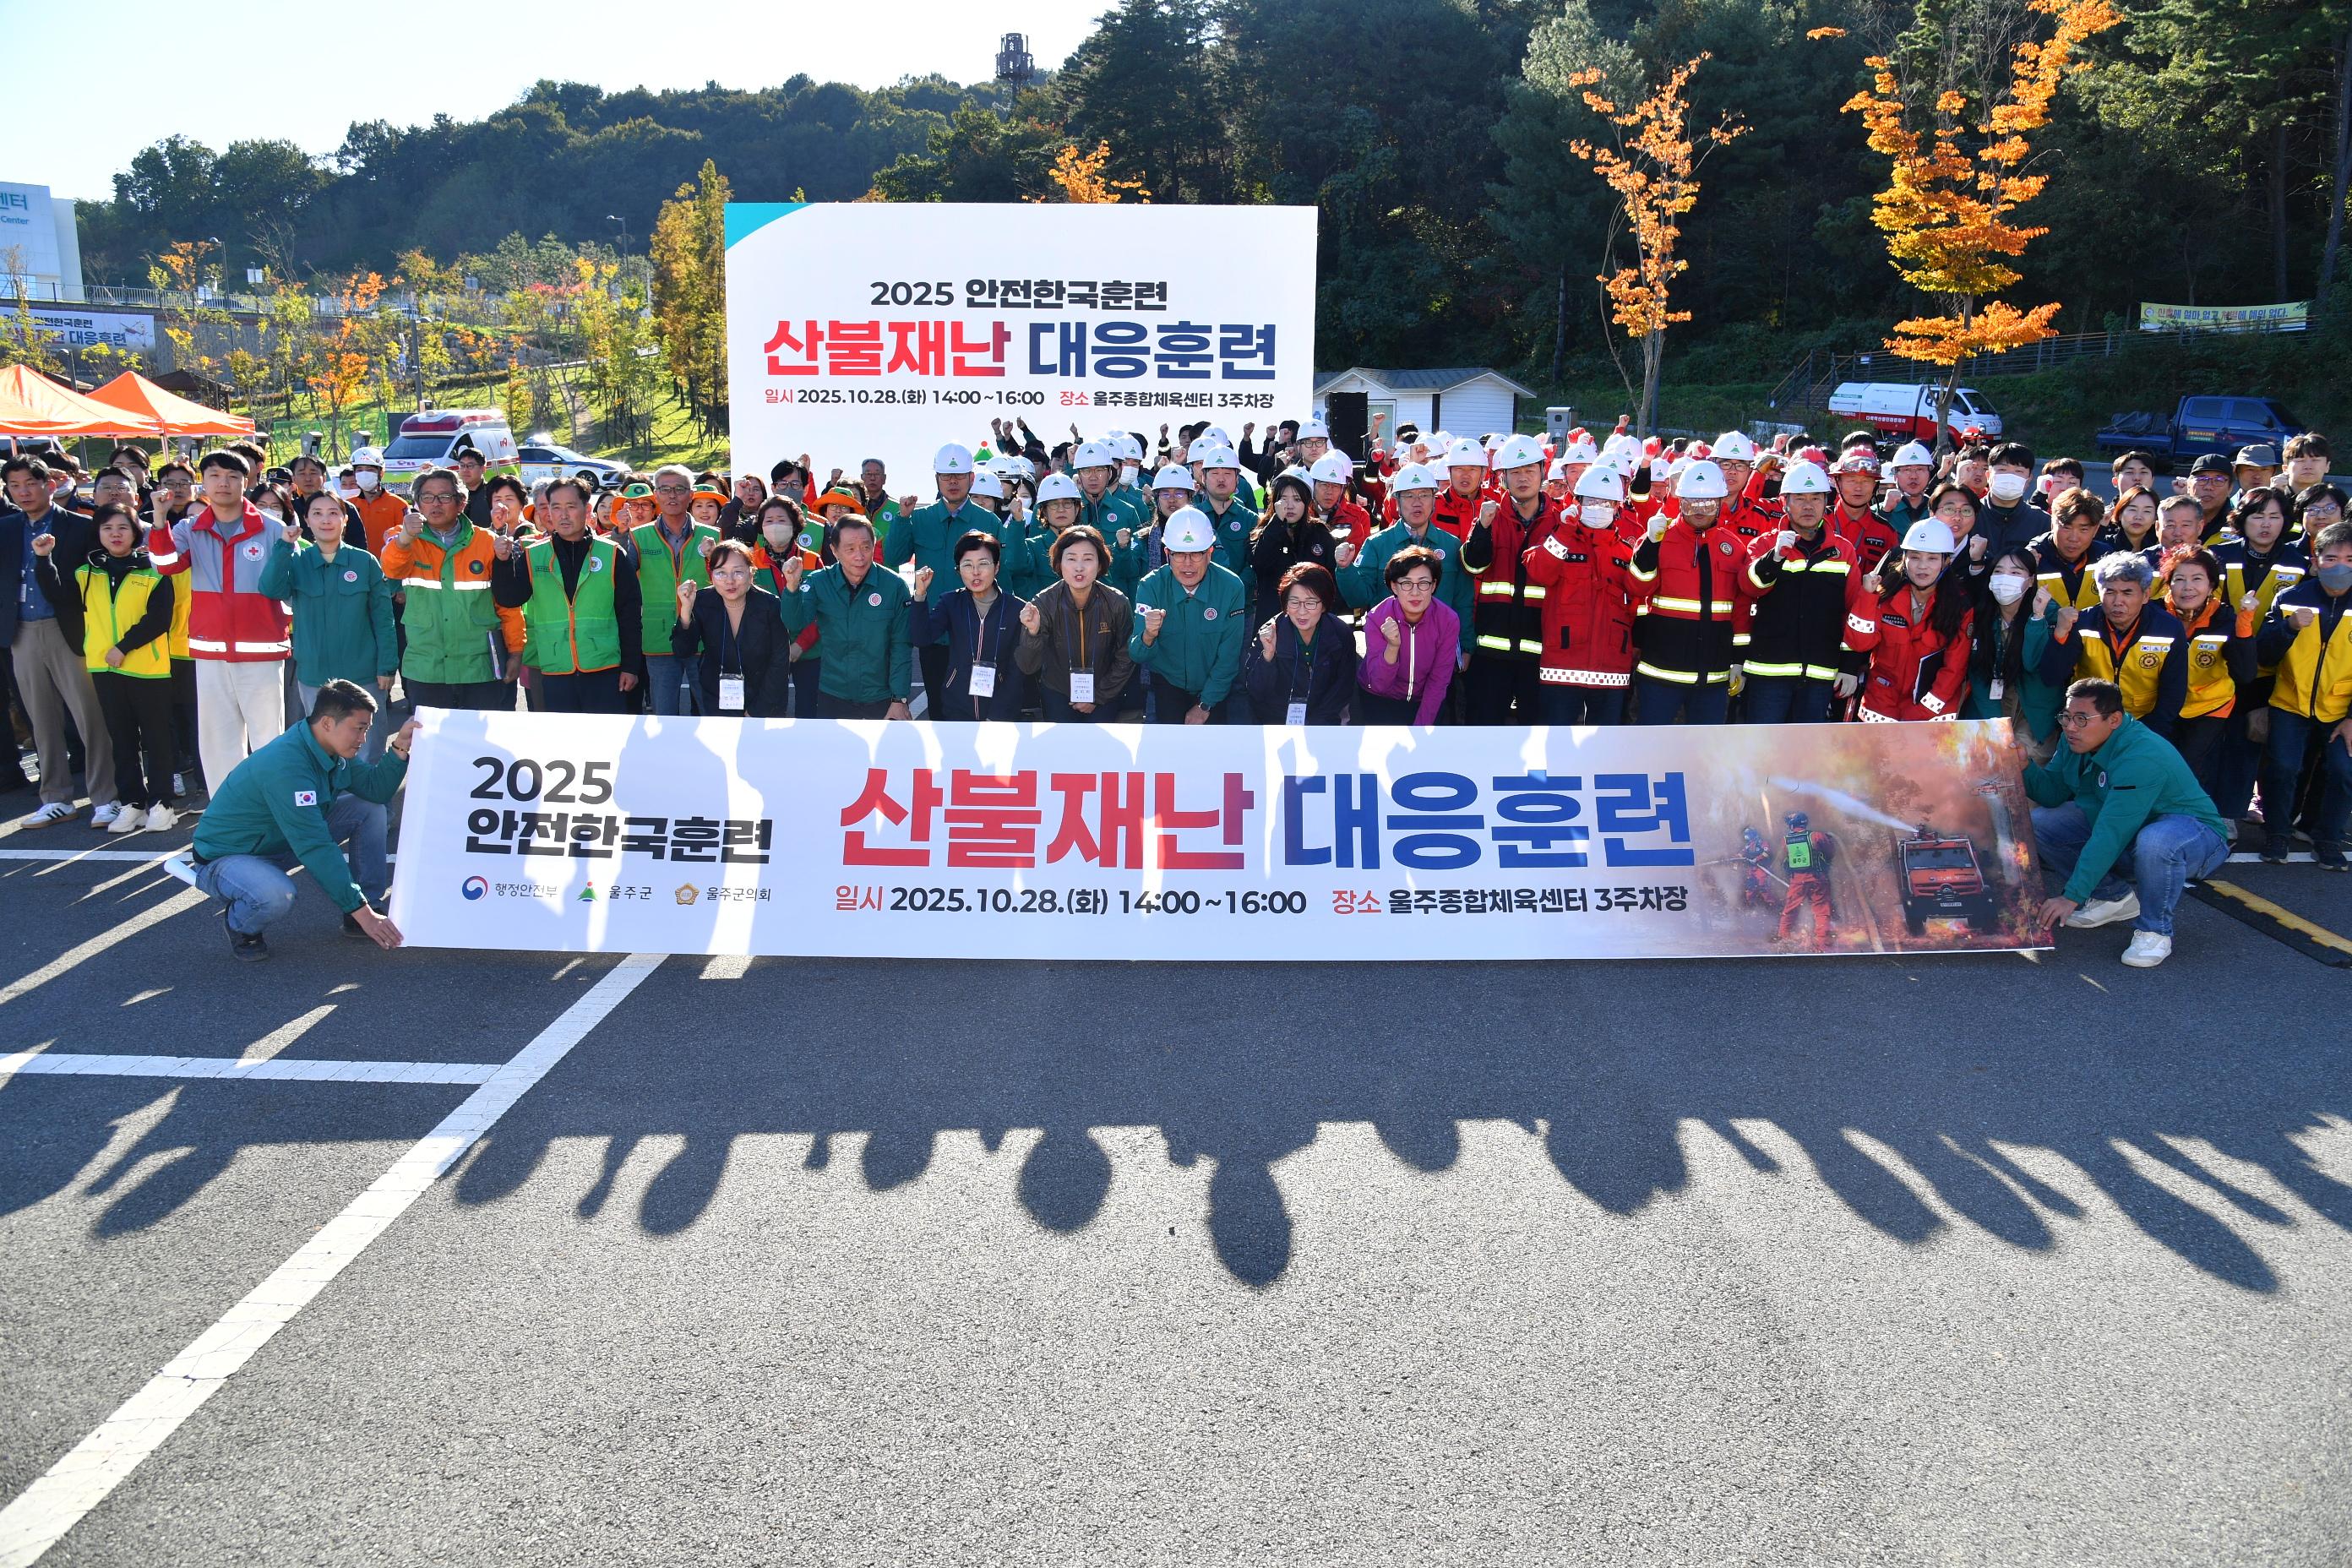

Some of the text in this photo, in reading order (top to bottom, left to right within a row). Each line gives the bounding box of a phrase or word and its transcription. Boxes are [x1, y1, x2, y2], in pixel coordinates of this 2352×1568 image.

[1, 215, 30, 225] Center
[870, 280, 1167, 311] 2025 안전한국훈련
[69, 330, 127, 346] 대응훈련
[764, 320, 1276, 379] 산불재난 대응훈련
[765, 389, 793, 404] 일시
[798, 389, 927, 406] 2025.10.28.(화)
[1060, 391, 1089, 406] 장소
[1093, 391, 1212, 409] 울주종합체육센터
[1217, 394, 1274, 409] 3주차장
[471, 757, 612, 804] 2025
[841, 768, 1695, 870] 산불재난 대응훈련
[466, 808, 772, 863] 안전한국훈련
[495, 882, 558, 898] 행정안전부
[609, 885, 652, 901] 울주군
[706, 886, 771, 902] 울주군의회
[836, 885, 883, 911] 일시
[890, 887, 1108, 915] 2025.10.28.(화)
[1332, 890, 1381, 914] 장소
[1389, 888, 1587, 914] 울주종합체육센터
[1594, 885, 1688, 912] 3주차장
